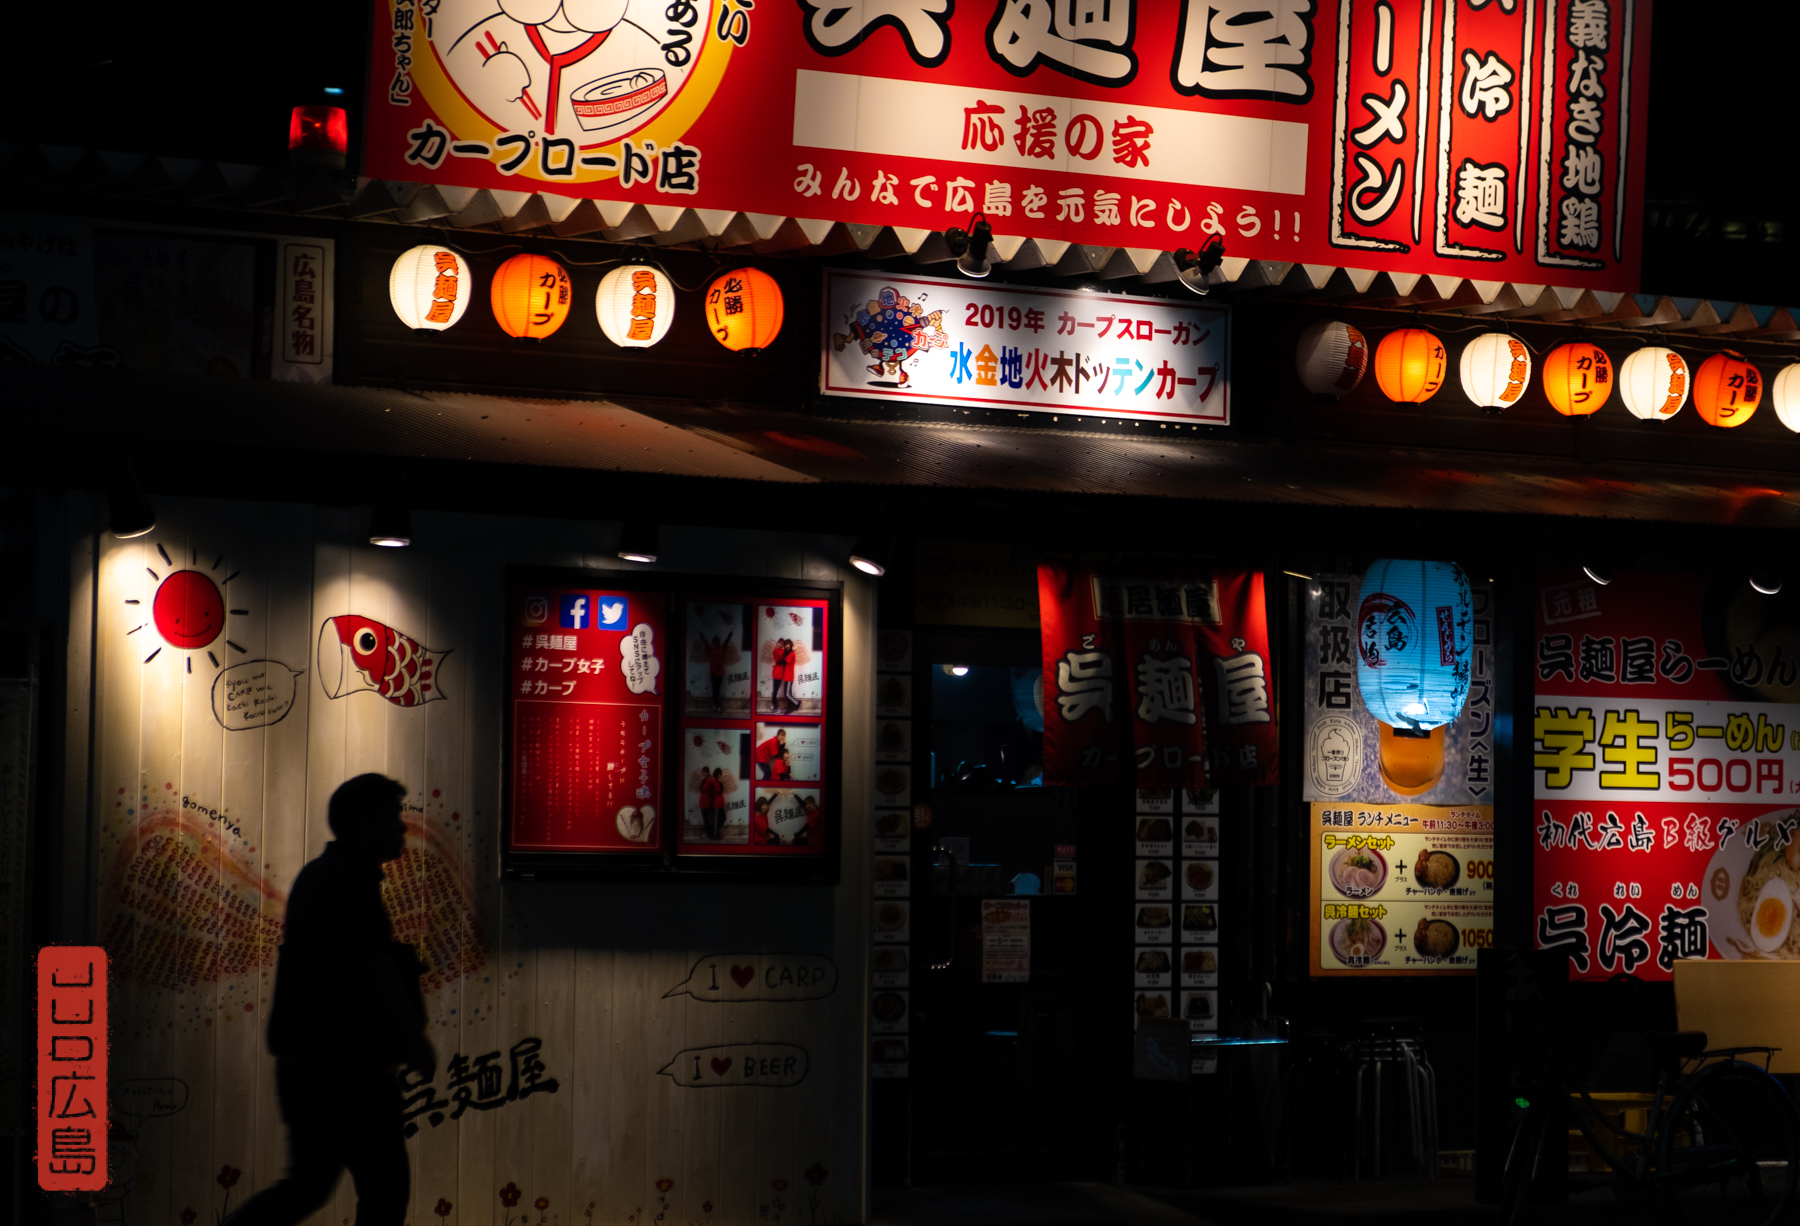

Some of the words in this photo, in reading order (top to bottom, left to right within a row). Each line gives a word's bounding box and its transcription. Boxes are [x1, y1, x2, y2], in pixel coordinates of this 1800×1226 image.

[717, 0, 753, 45] い
[390, 0, 415, 106] 郎ちゃん」
[961, 100, 1154, 168] 応援の家
[1455, 0, 1514, 229] 冷麺
[406, 121, 701, 194] カープロード店
[290, 253, 315, 356] 広島名物
[425, 251, 459, 323] 呉麺屋
[532, 272, 557, 326] カープ
[626, 270, 657, 341] 呉麺屋
[723, 277, 744, 316] 必勝
[709, 288, 730, 342] カープ
[965, 302, 1045, 332] 2019年
[1057, 311, 1211, 346] カープスローガン
[950, 342, 1220, 403] 水金地火木ドッテンカープ
[1573, 356, 1593, 403] カープ
[1720, 373, 1744, 418] カープ
[1553, 586, 1598, 617] 元祖
[521, 634, 578, 651] #呉麺屋
[1318, 580, 1352, 710] 取扱店
[1538, 635, 1798, 687] 呉麺屋らーめん
[521, 656, 605, 675] #カープ女子
[520, 679, 577, 696] #カープ
[1056, 651, 1271, 726] 呉麺屋
[1534, 708, 1661, 789] 学生
[1665, 711, 1785, 753] らーめん
[1082, 744, 1258, 770] カープロード店
[1668, 758, 1784, 794] 500円
[1322, 810, 1353, 827] 呉麺屋
[1450, 811, 1481, 819] ランチタイム
[1538, 811, 1798, 852] 初代広島B級グルメ
[1325, 835, 1395, 850] ラーメンセット
[1057, 864, 1074, 872] VISA
[1346, 887, 1374, 895] ラーメン
[1550, 881, 1580, 899] くれ
[1614, 881, 1642, 899] れい
[1671, 882, 1700, 900] めん
[1324, 904, 1387, 919] 呉冷麺セット
[1538, 904, 1709, 973] 呉冷麺
[765, 966, 826, 989] CARP
[1348, 955, 1371, 965] 呉冷麺
[743, 1055, 798, 1078] BEER
